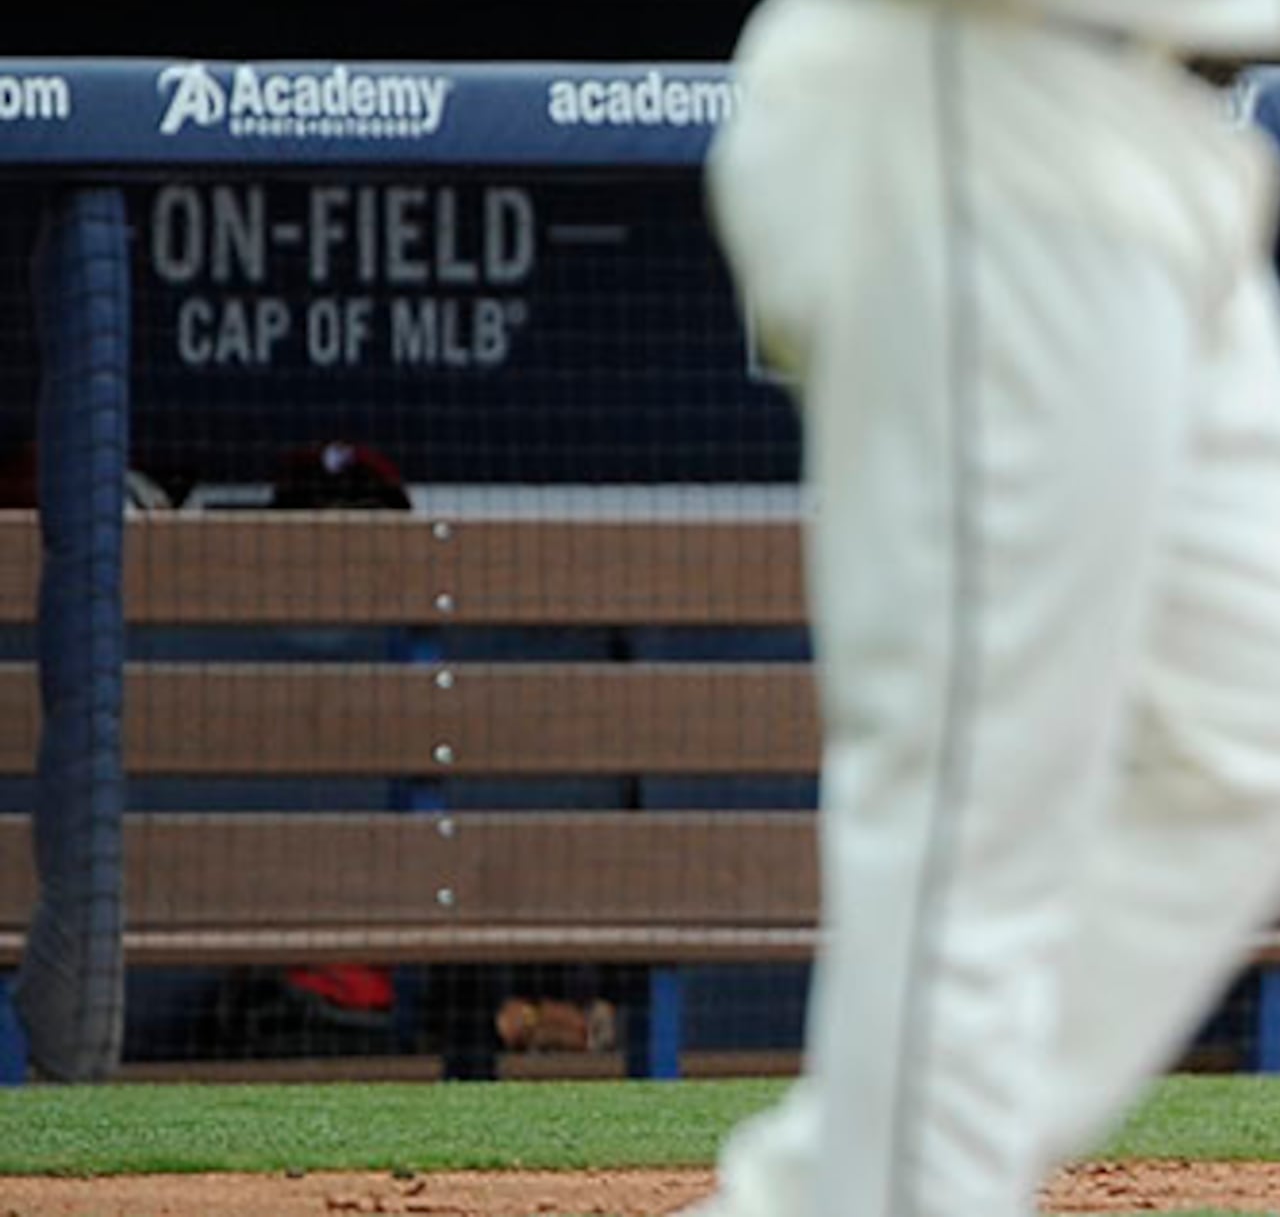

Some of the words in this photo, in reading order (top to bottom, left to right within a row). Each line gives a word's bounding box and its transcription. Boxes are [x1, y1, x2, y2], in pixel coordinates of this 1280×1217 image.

[229, 64, 452, 133] Academy
[547, 70, 733, 125] academ
[152, 184, 536, 284] ON-FIELD
[177, 298, 290, 365] CAP
[306, 298, 374, 365] OF
